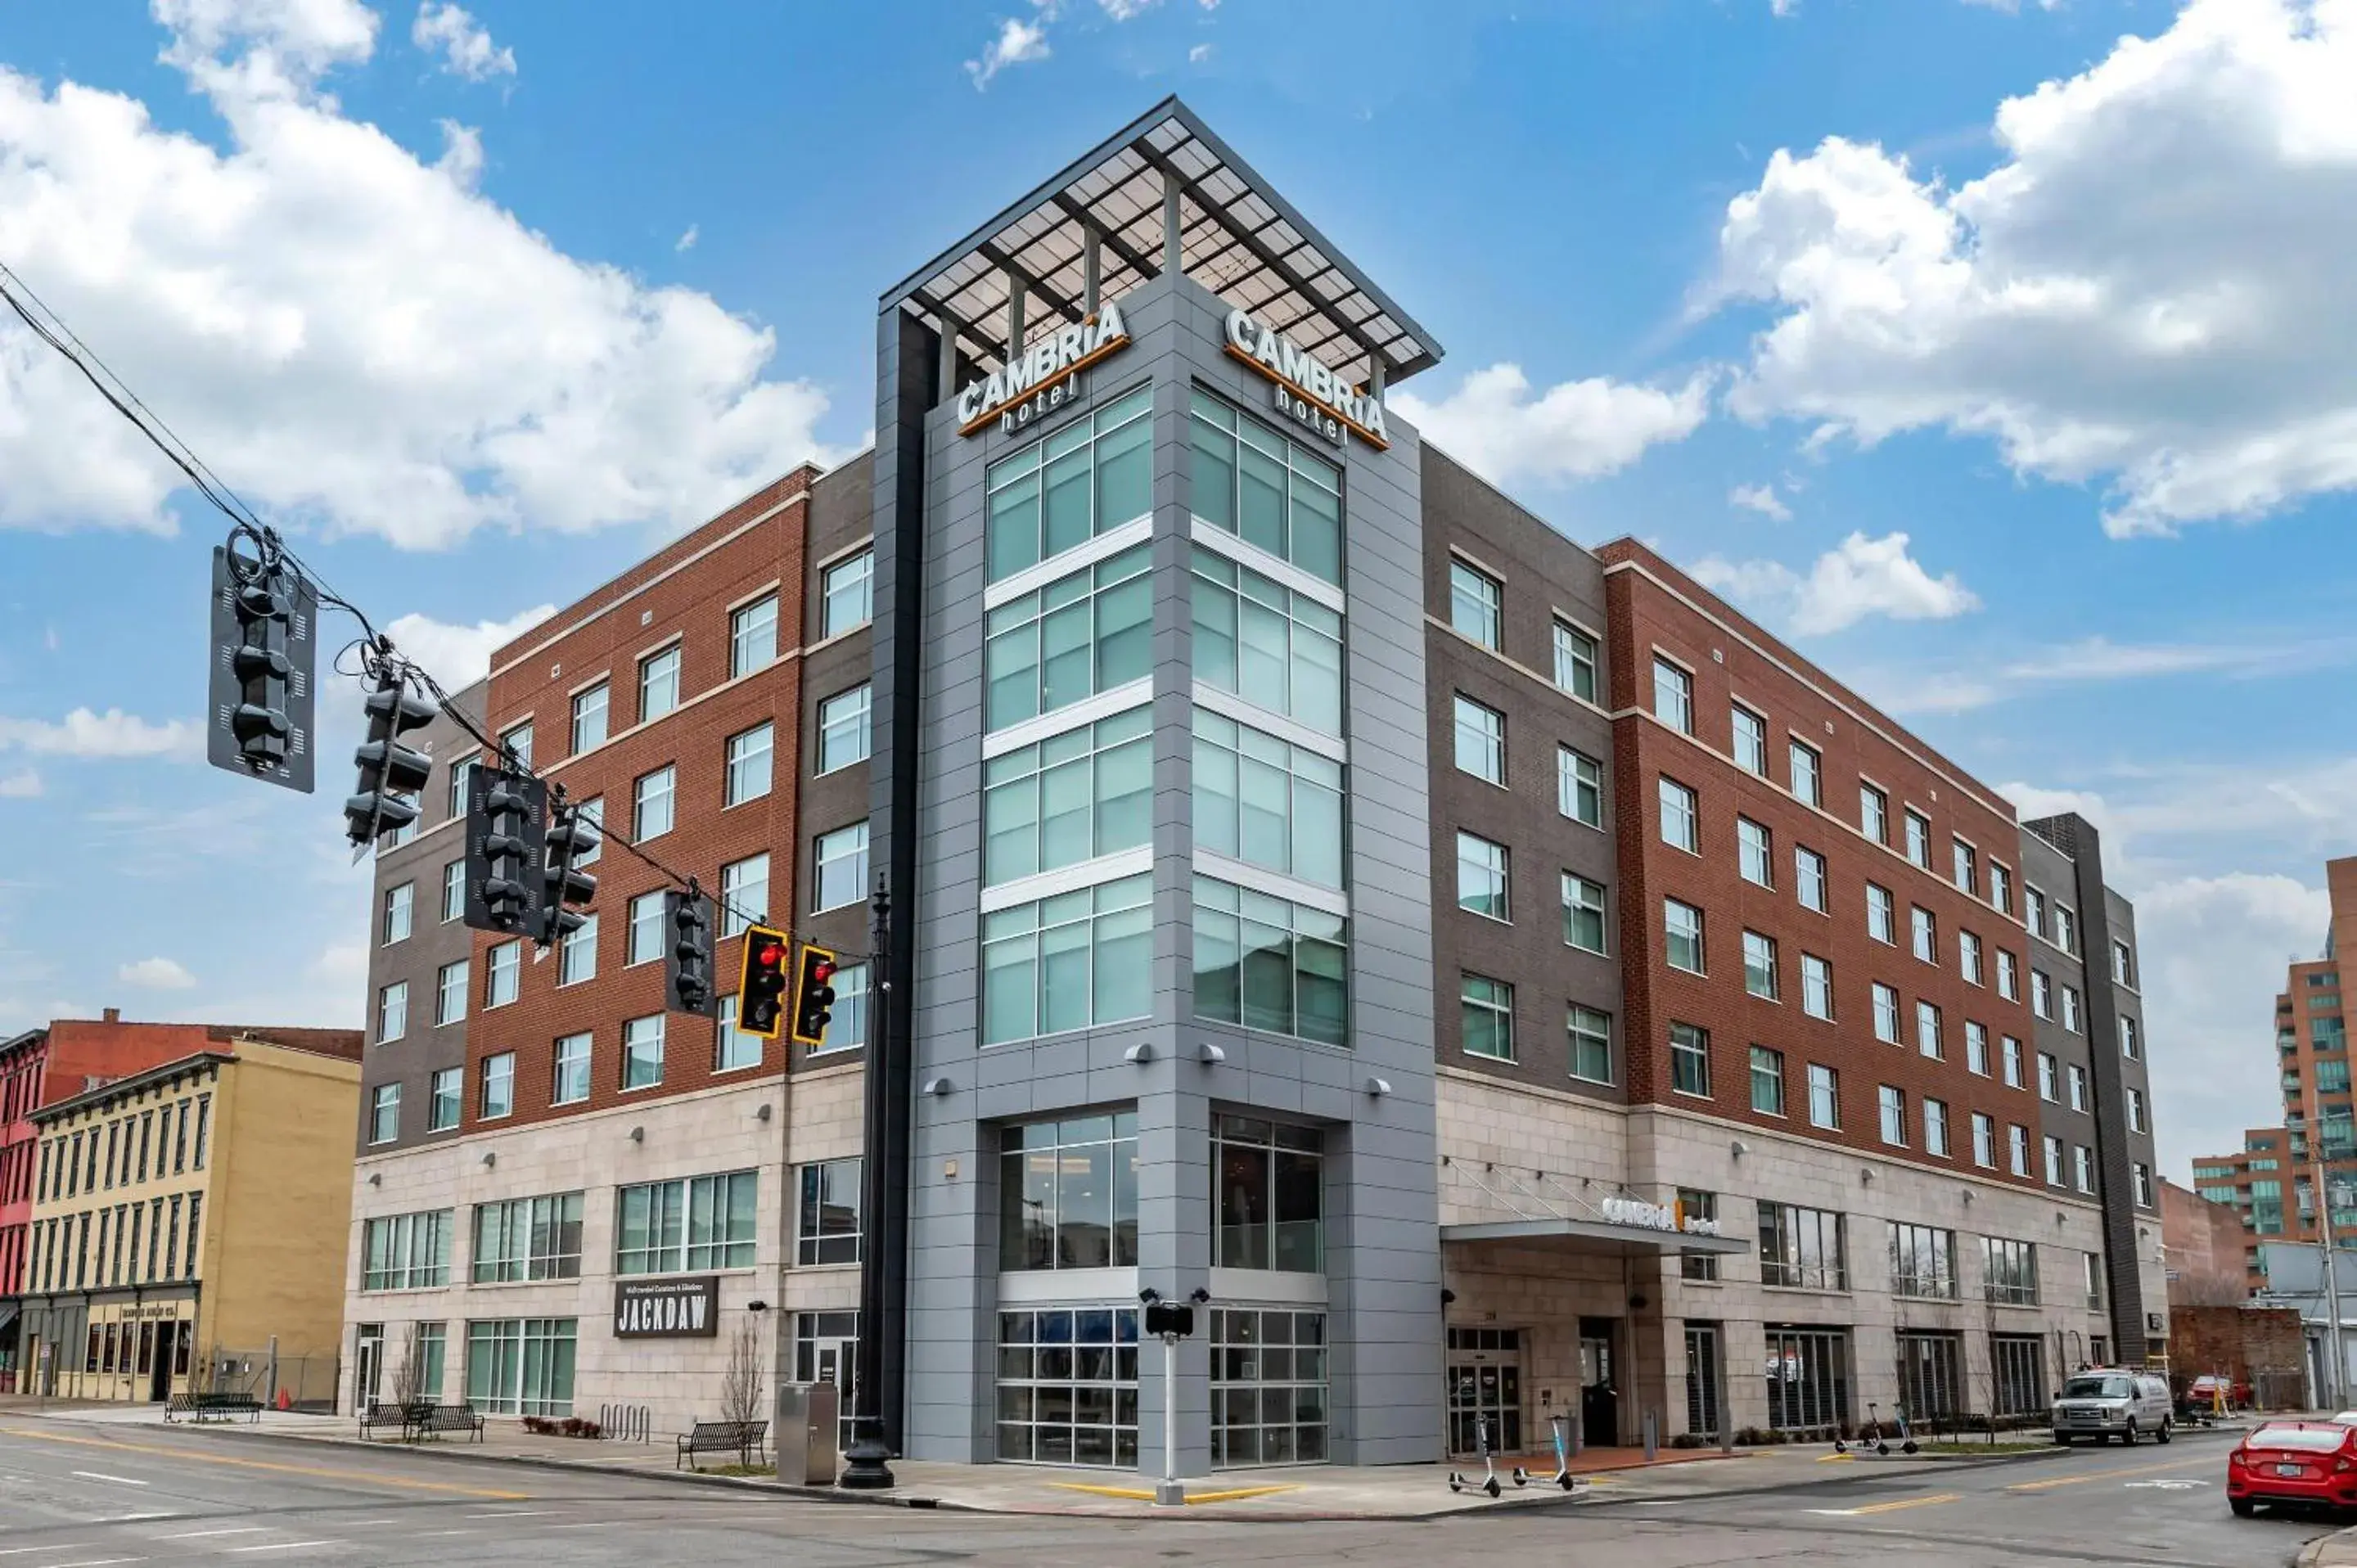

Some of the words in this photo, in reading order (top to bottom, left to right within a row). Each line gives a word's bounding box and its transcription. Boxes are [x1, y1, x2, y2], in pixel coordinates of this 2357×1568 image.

[958, 300, 1126, 424] CAMBRIA
[1226, 309, 1389, 443] CAMBRIA
[1001, 372, 1077, 433] hotel
[1275, 383, 1349, 445] hotel
[618, 1295, 707, 1331] JACKDAW
